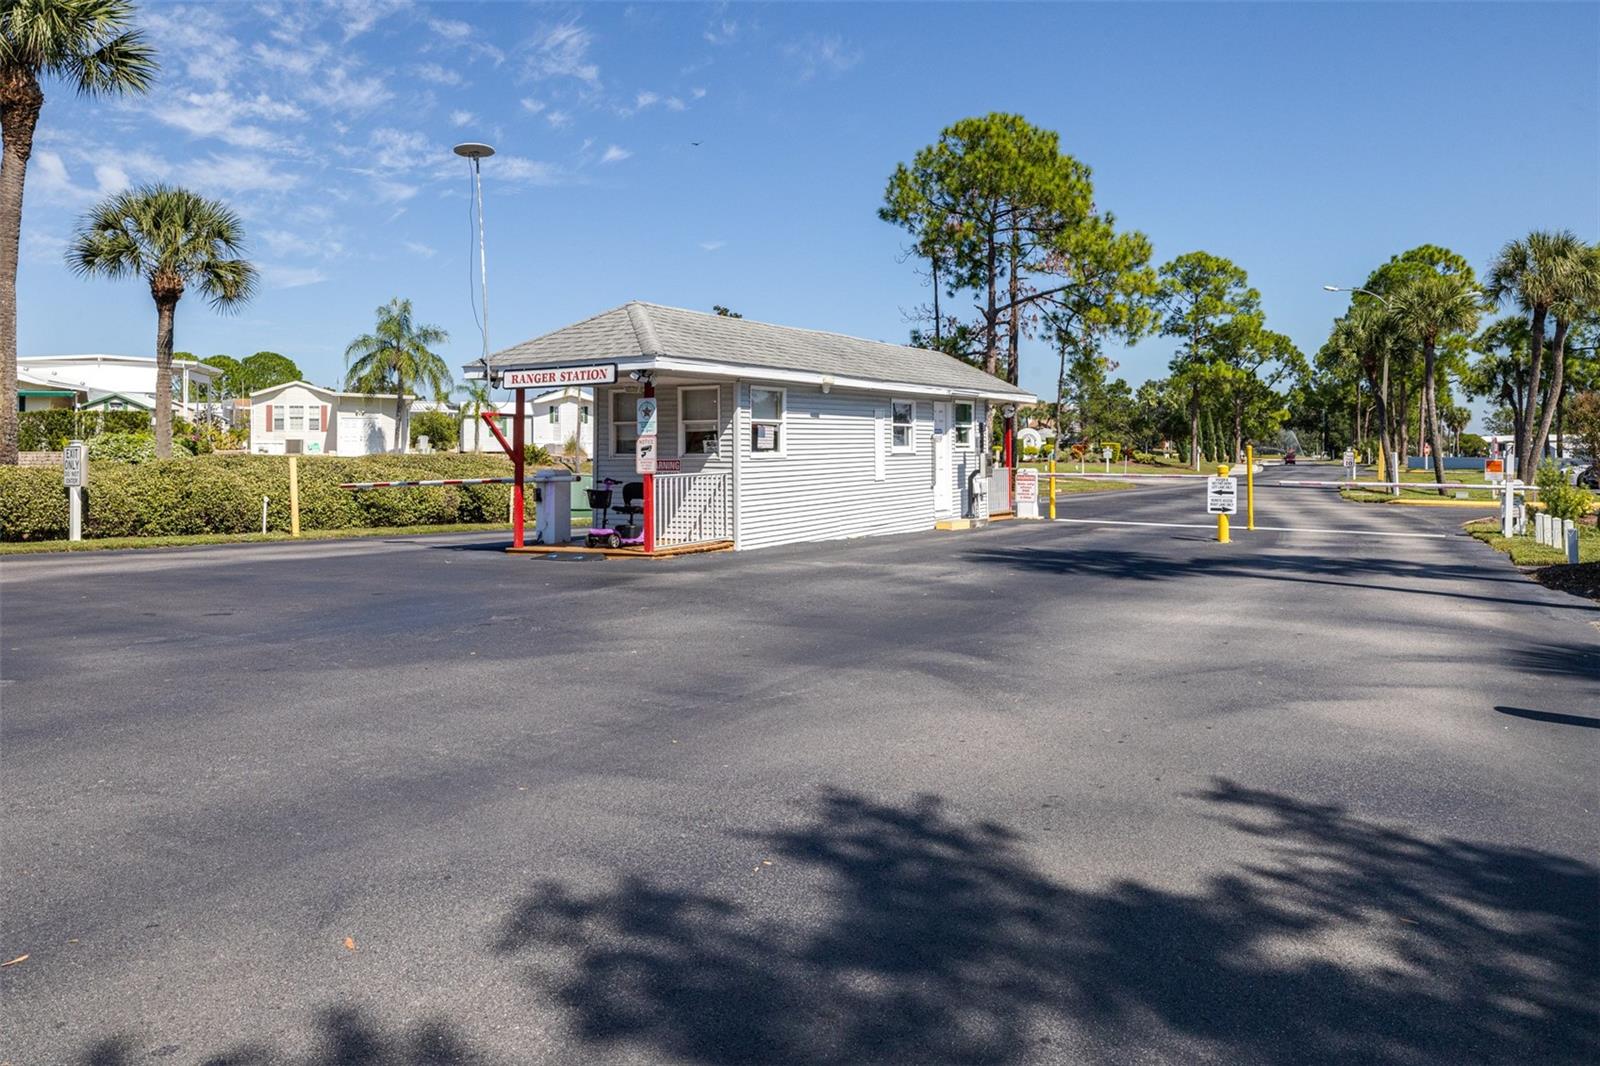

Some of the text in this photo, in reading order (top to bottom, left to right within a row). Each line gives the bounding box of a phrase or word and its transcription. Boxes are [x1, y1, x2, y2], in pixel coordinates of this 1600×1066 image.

[511, 368, 608, 385] RANGER STATION
[66, 448, 78, 459] EXIT
[65, 459, 79, 470] ONLY
